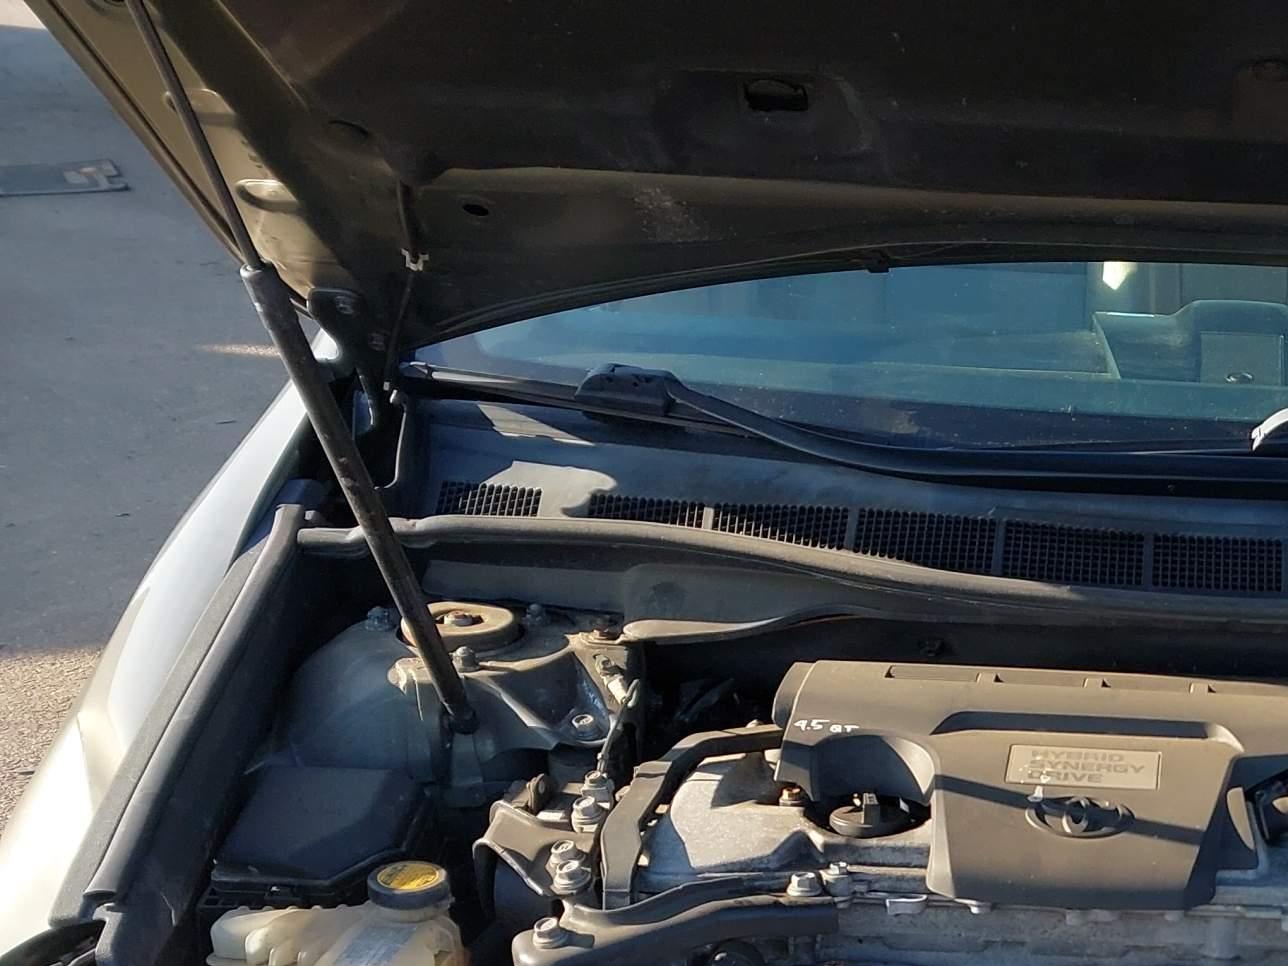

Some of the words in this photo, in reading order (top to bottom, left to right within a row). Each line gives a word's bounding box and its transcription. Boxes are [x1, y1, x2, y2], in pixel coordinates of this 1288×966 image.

[1031, 750, 1125, 762] HYBRID
[1028, 760, 1145, 774] SYNERGY
[1027, 771, 1104, 784] DRIVE
